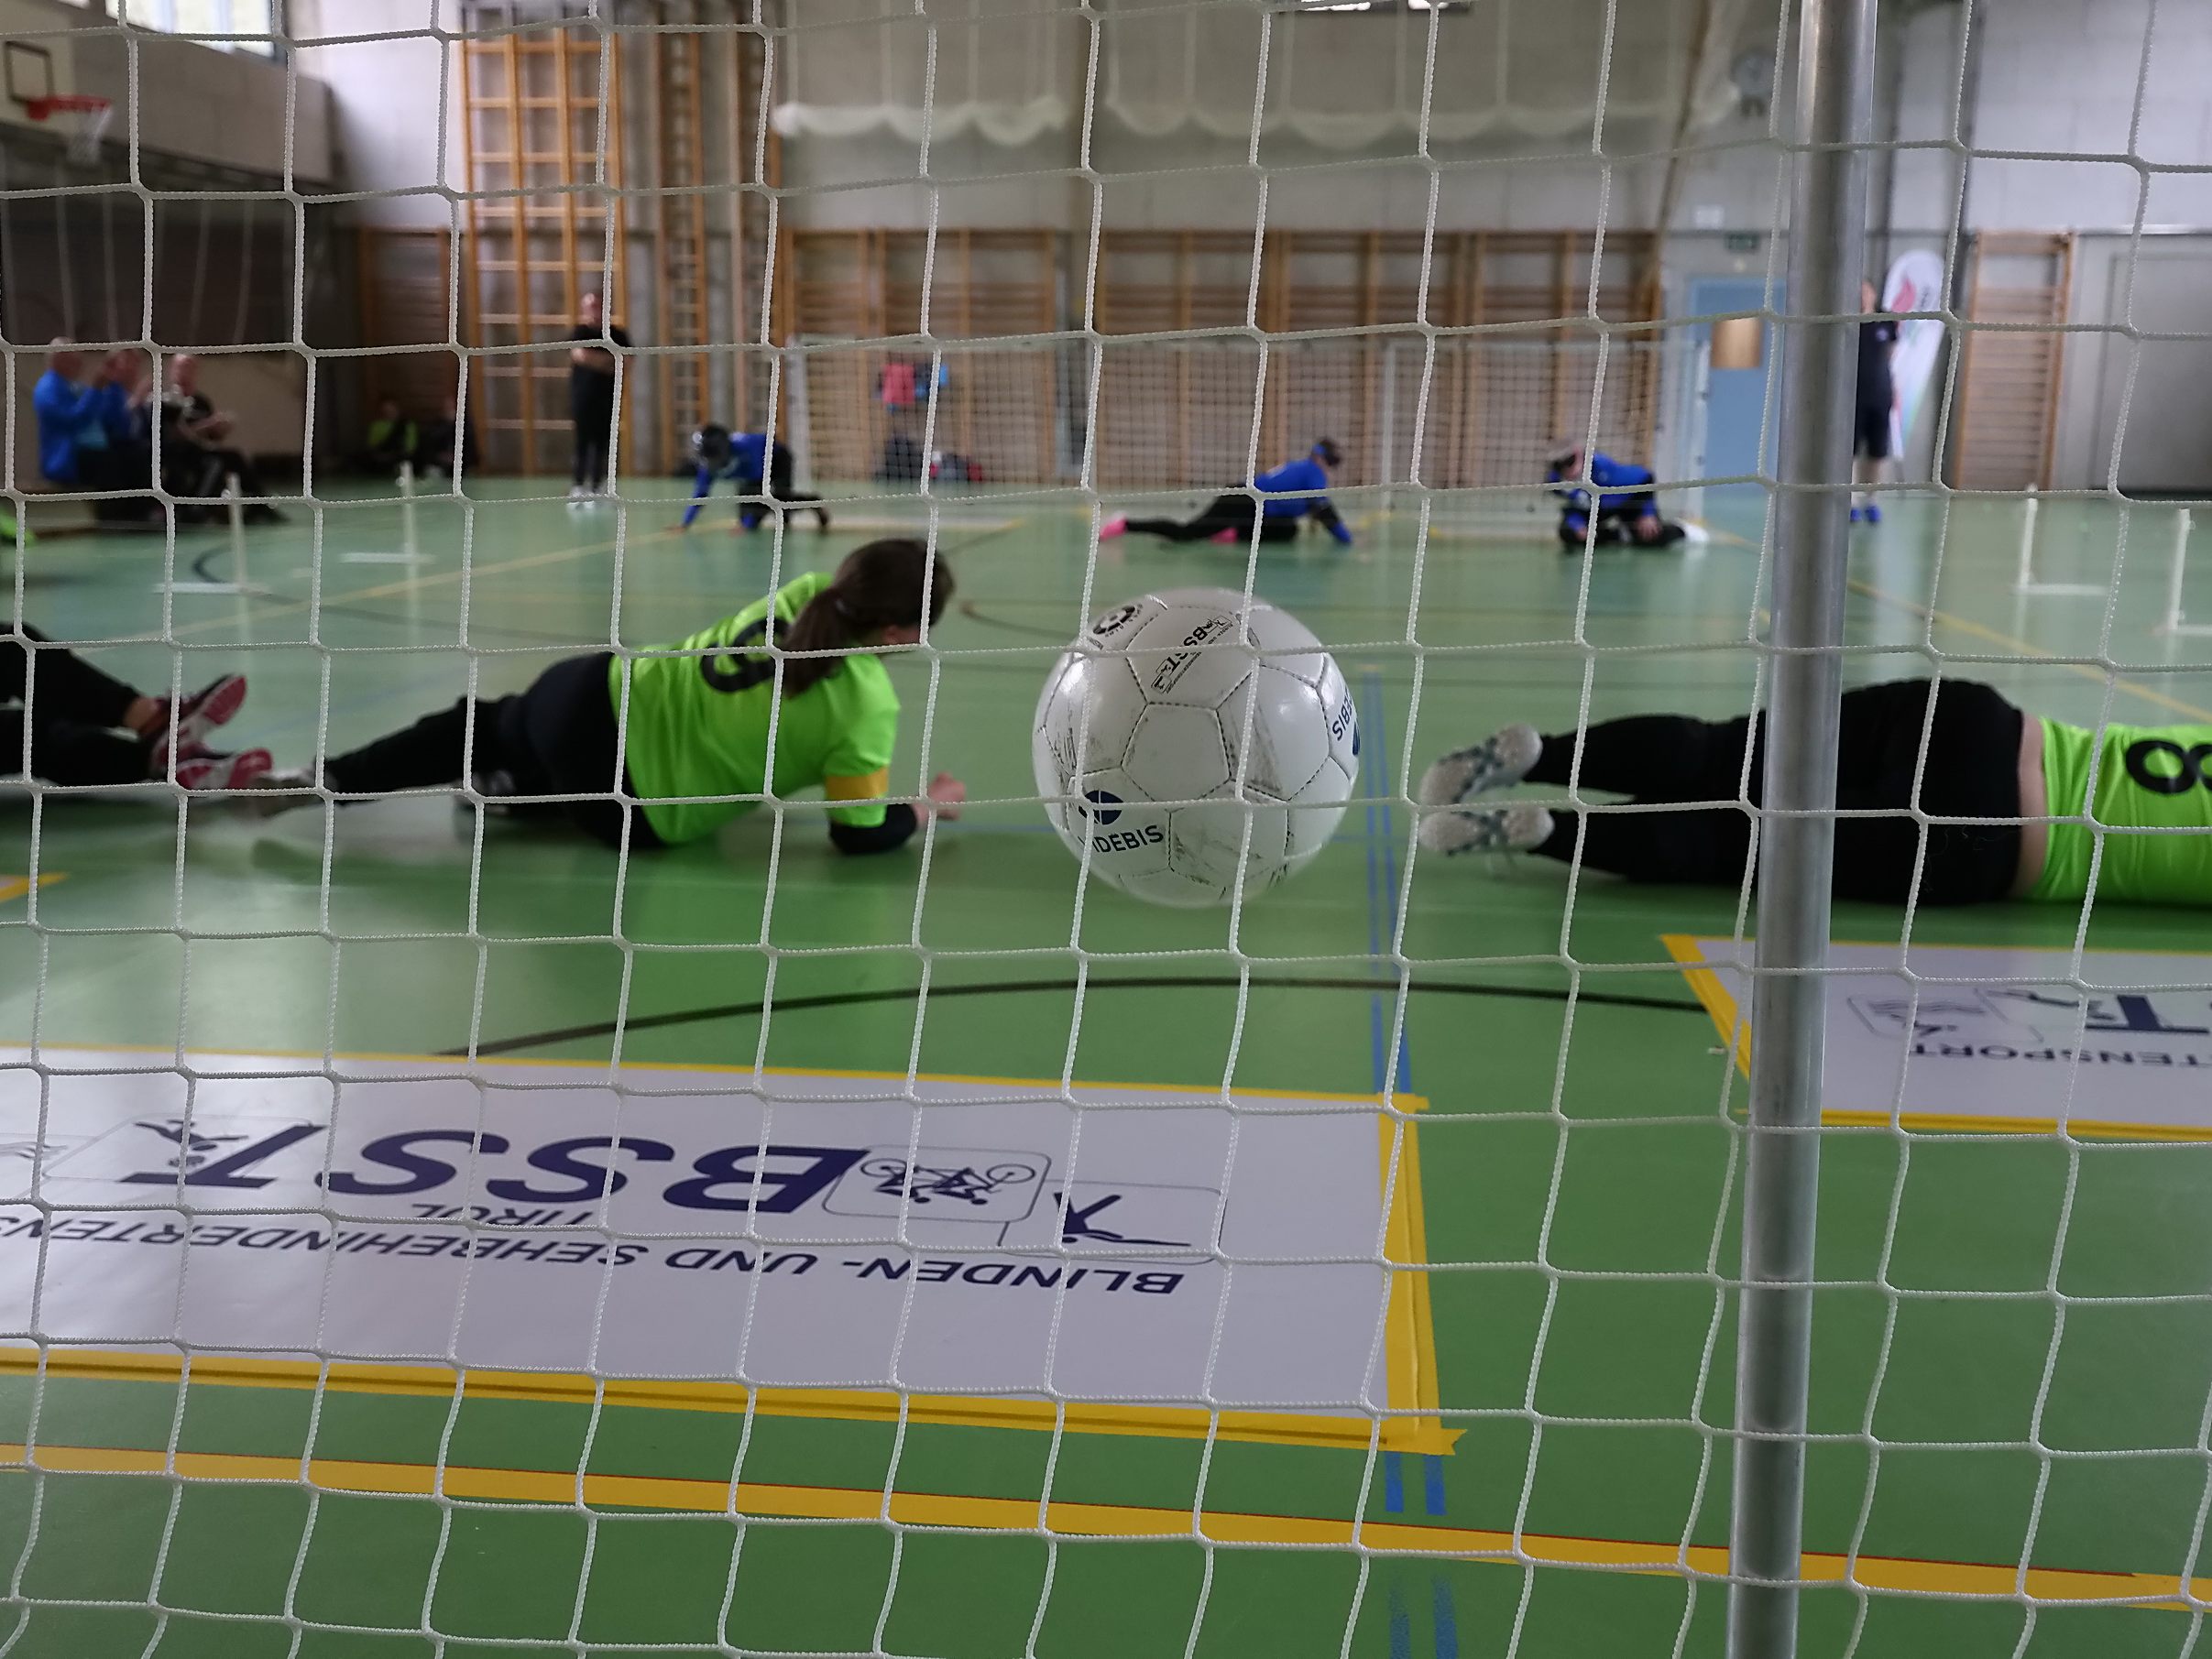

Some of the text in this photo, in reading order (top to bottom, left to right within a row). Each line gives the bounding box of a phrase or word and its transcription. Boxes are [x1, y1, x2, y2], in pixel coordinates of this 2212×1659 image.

[119, 1124, 870, 1214] BSST
[665, 1247, 818, 1274] UND
[842, 1255, 1184, 1294] BLINDEN-
